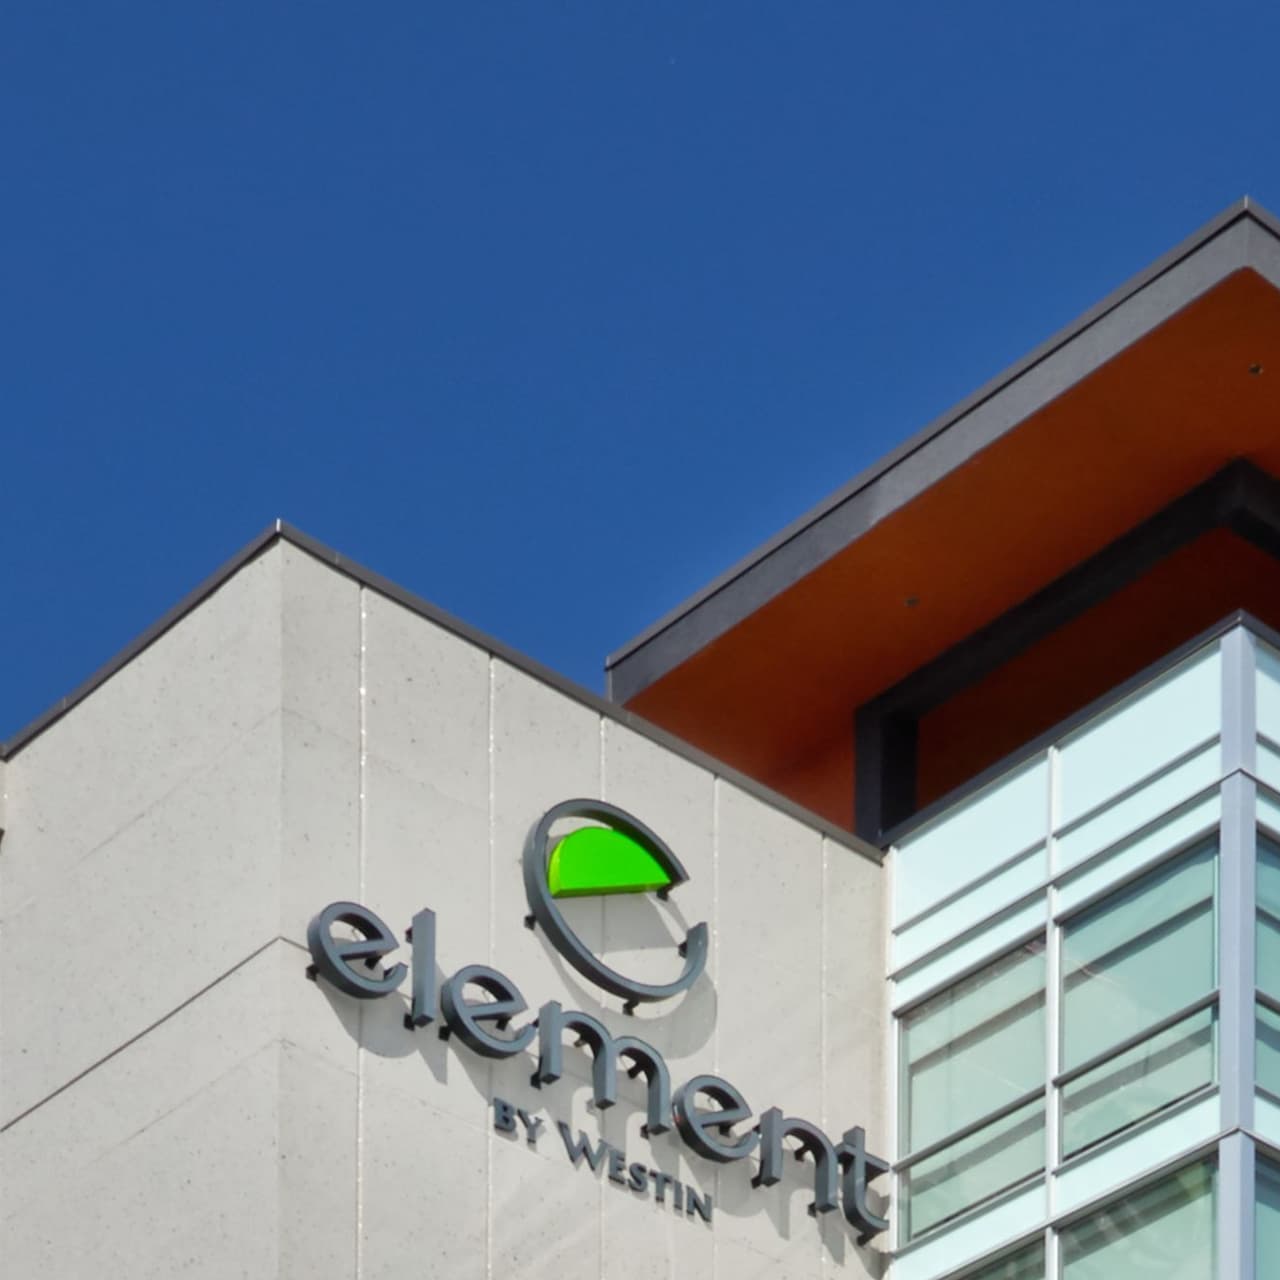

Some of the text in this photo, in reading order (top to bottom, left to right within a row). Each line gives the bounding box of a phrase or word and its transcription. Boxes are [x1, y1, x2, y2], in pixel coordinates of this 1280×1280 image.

[307, 902, 889, 1234] element
[494, 1097, 712, 1223] BY WESTIN
